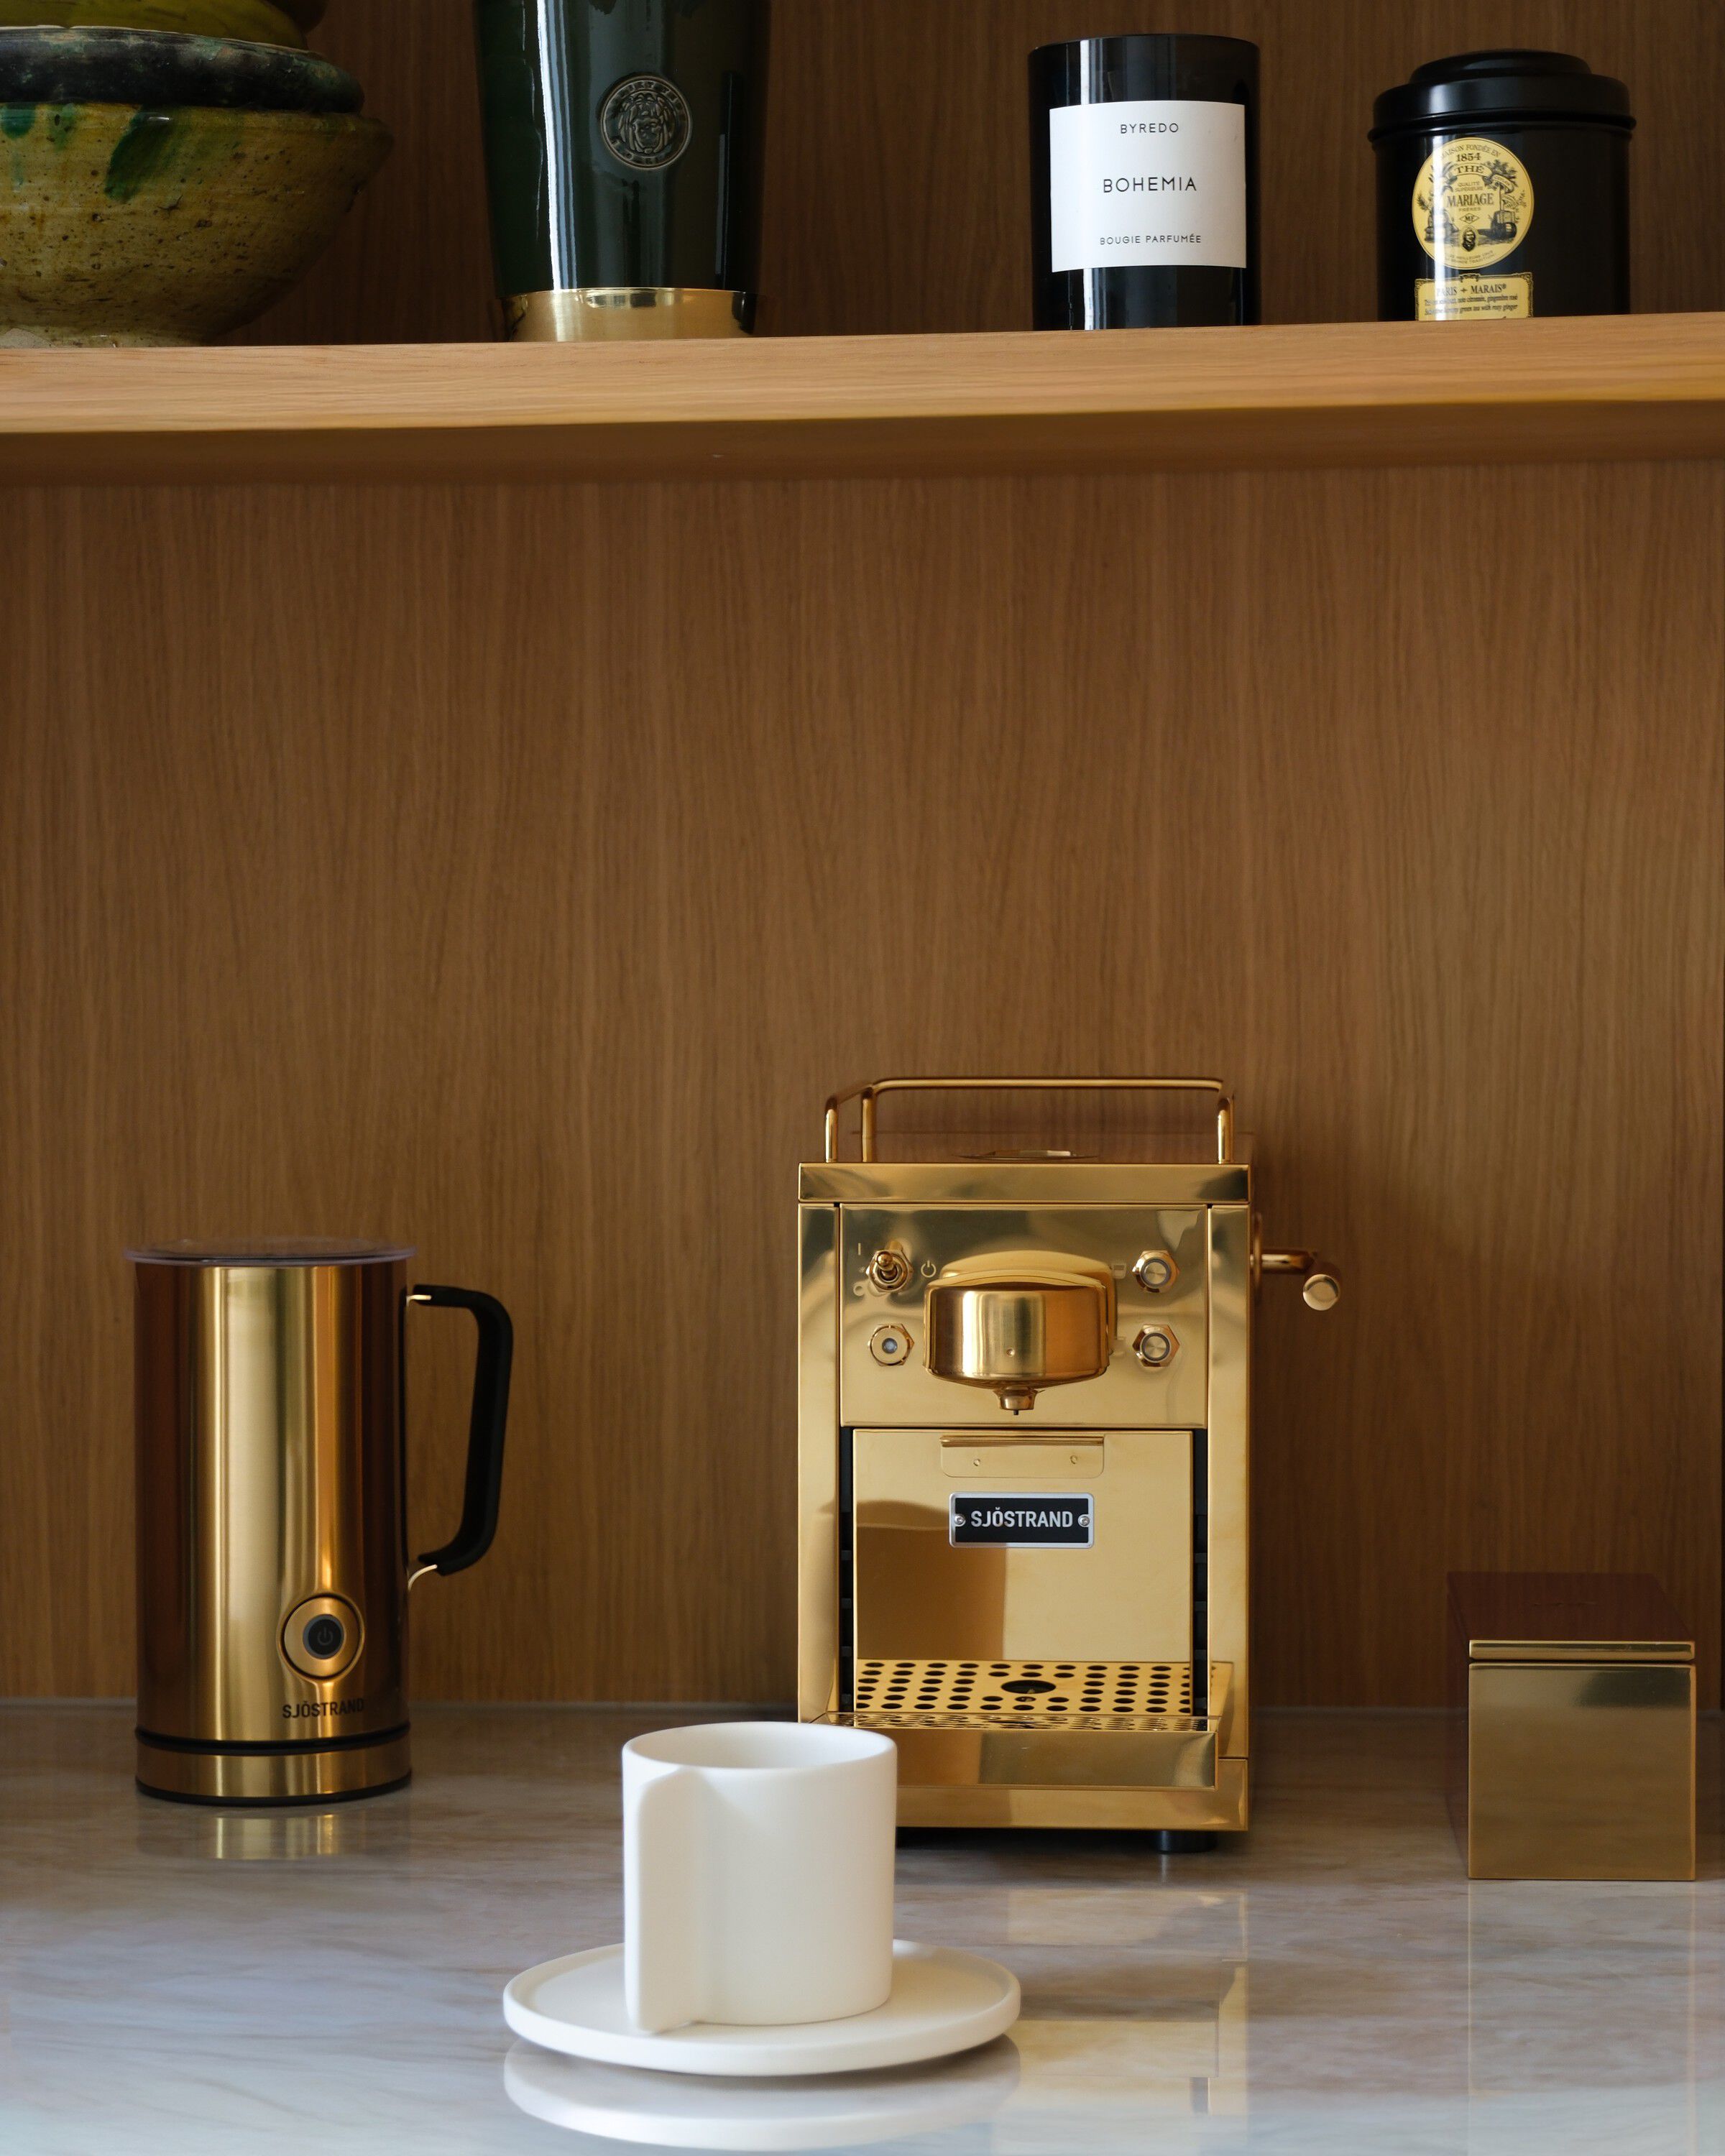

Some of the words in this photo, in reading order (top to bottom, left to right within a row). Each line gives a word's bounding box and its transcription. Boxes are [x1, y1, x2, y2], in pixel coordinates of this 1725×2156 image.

[1120, 122, 1179, 134] BYREDO
[1456, 152, 1481, 162] 1854
[1103, 176, 1197, 193] BOHEMIA
[1447, 193, 1494, 208] MARIAGE
[1100, 236, 1141, 245] BOUGIE
[1145, 233, 1202, 243] PARFUMÉE
[282, 1697, 364, 1718] SJÖSTRAND
